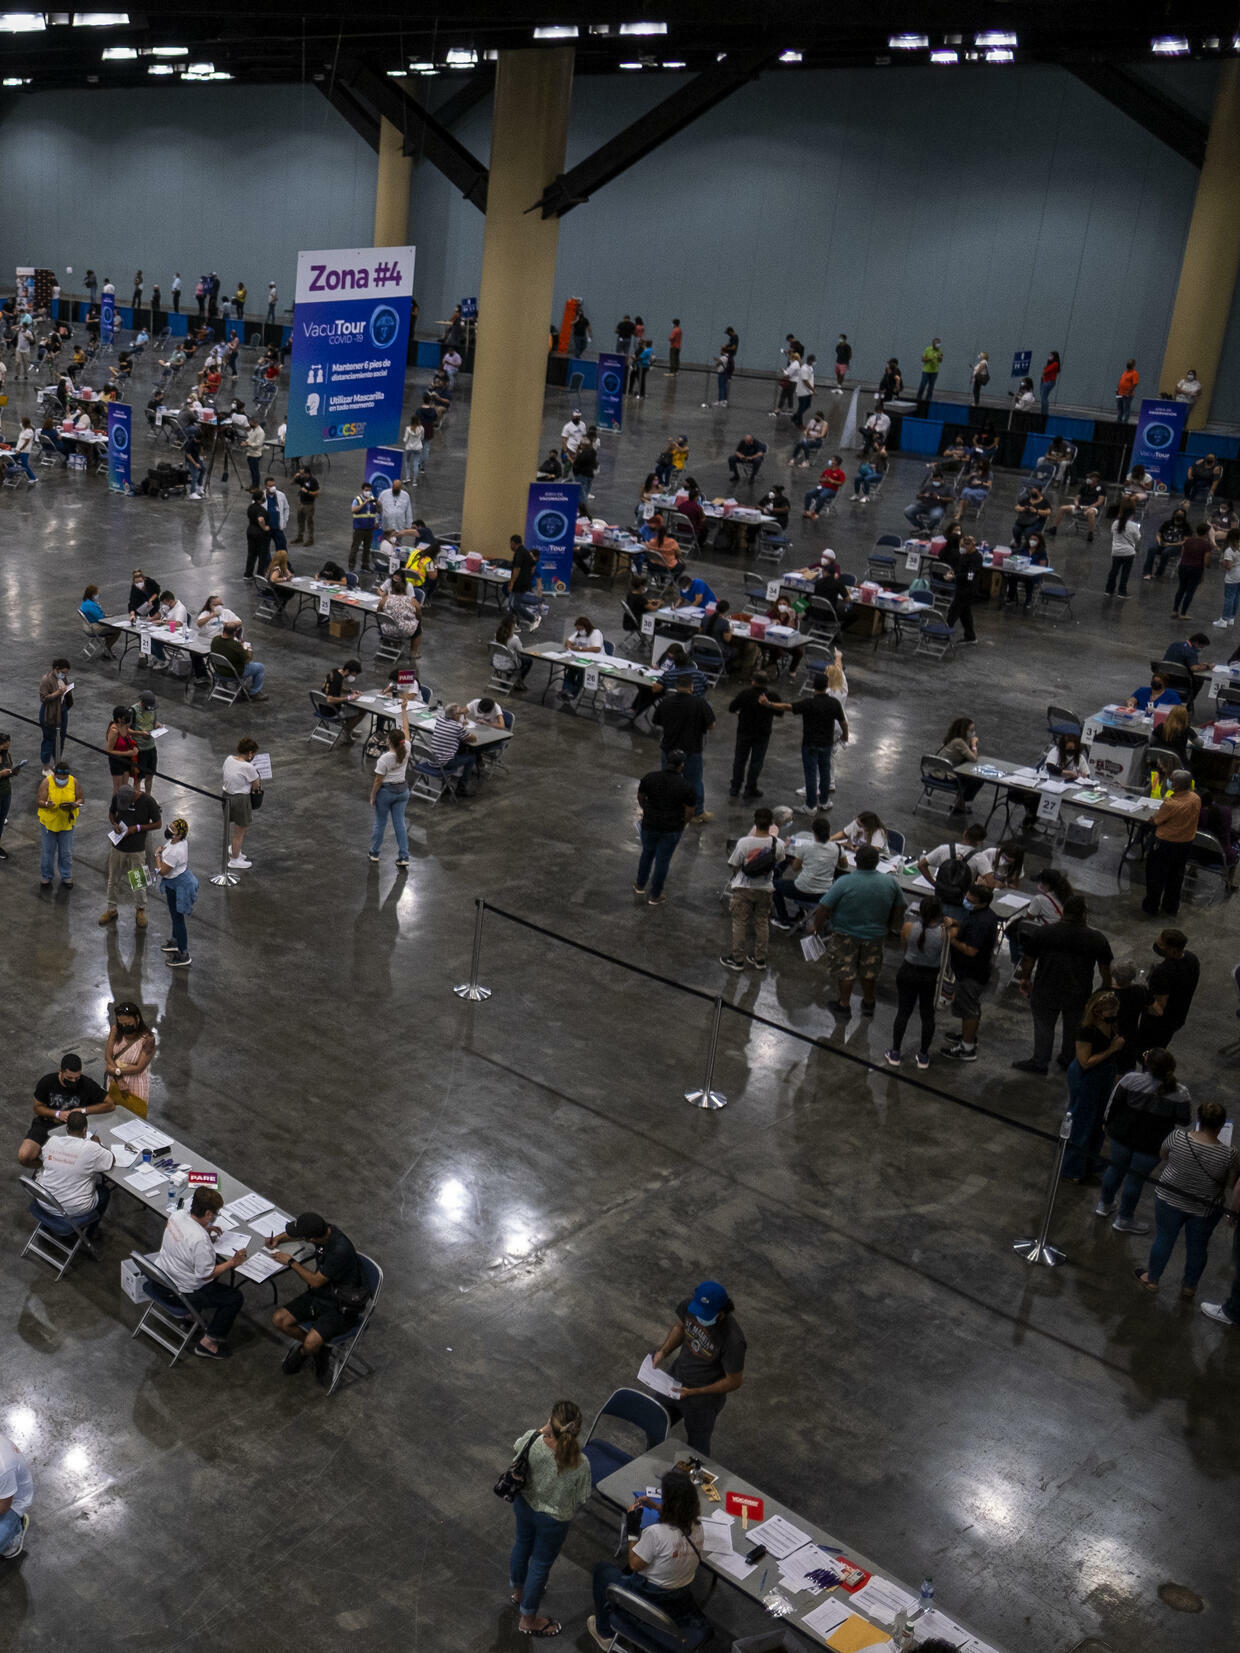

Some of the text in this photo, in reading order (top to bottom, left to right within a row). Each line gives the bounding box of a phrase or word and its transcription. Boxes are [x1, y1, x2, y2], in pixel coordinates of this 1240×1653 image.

[309, 261, 402, 292] Zona #4
[303, 319, 367, 338] VacuTour
[328, 335, 353, 345] COVID
[332, 358, 391, 372] Mantener 6 pies de
[330, 391, 384, 405] Utilizar Mascarilla
[1043, 799, 1056, 810] 27
[190, 1174, 216, 1182] PARE
